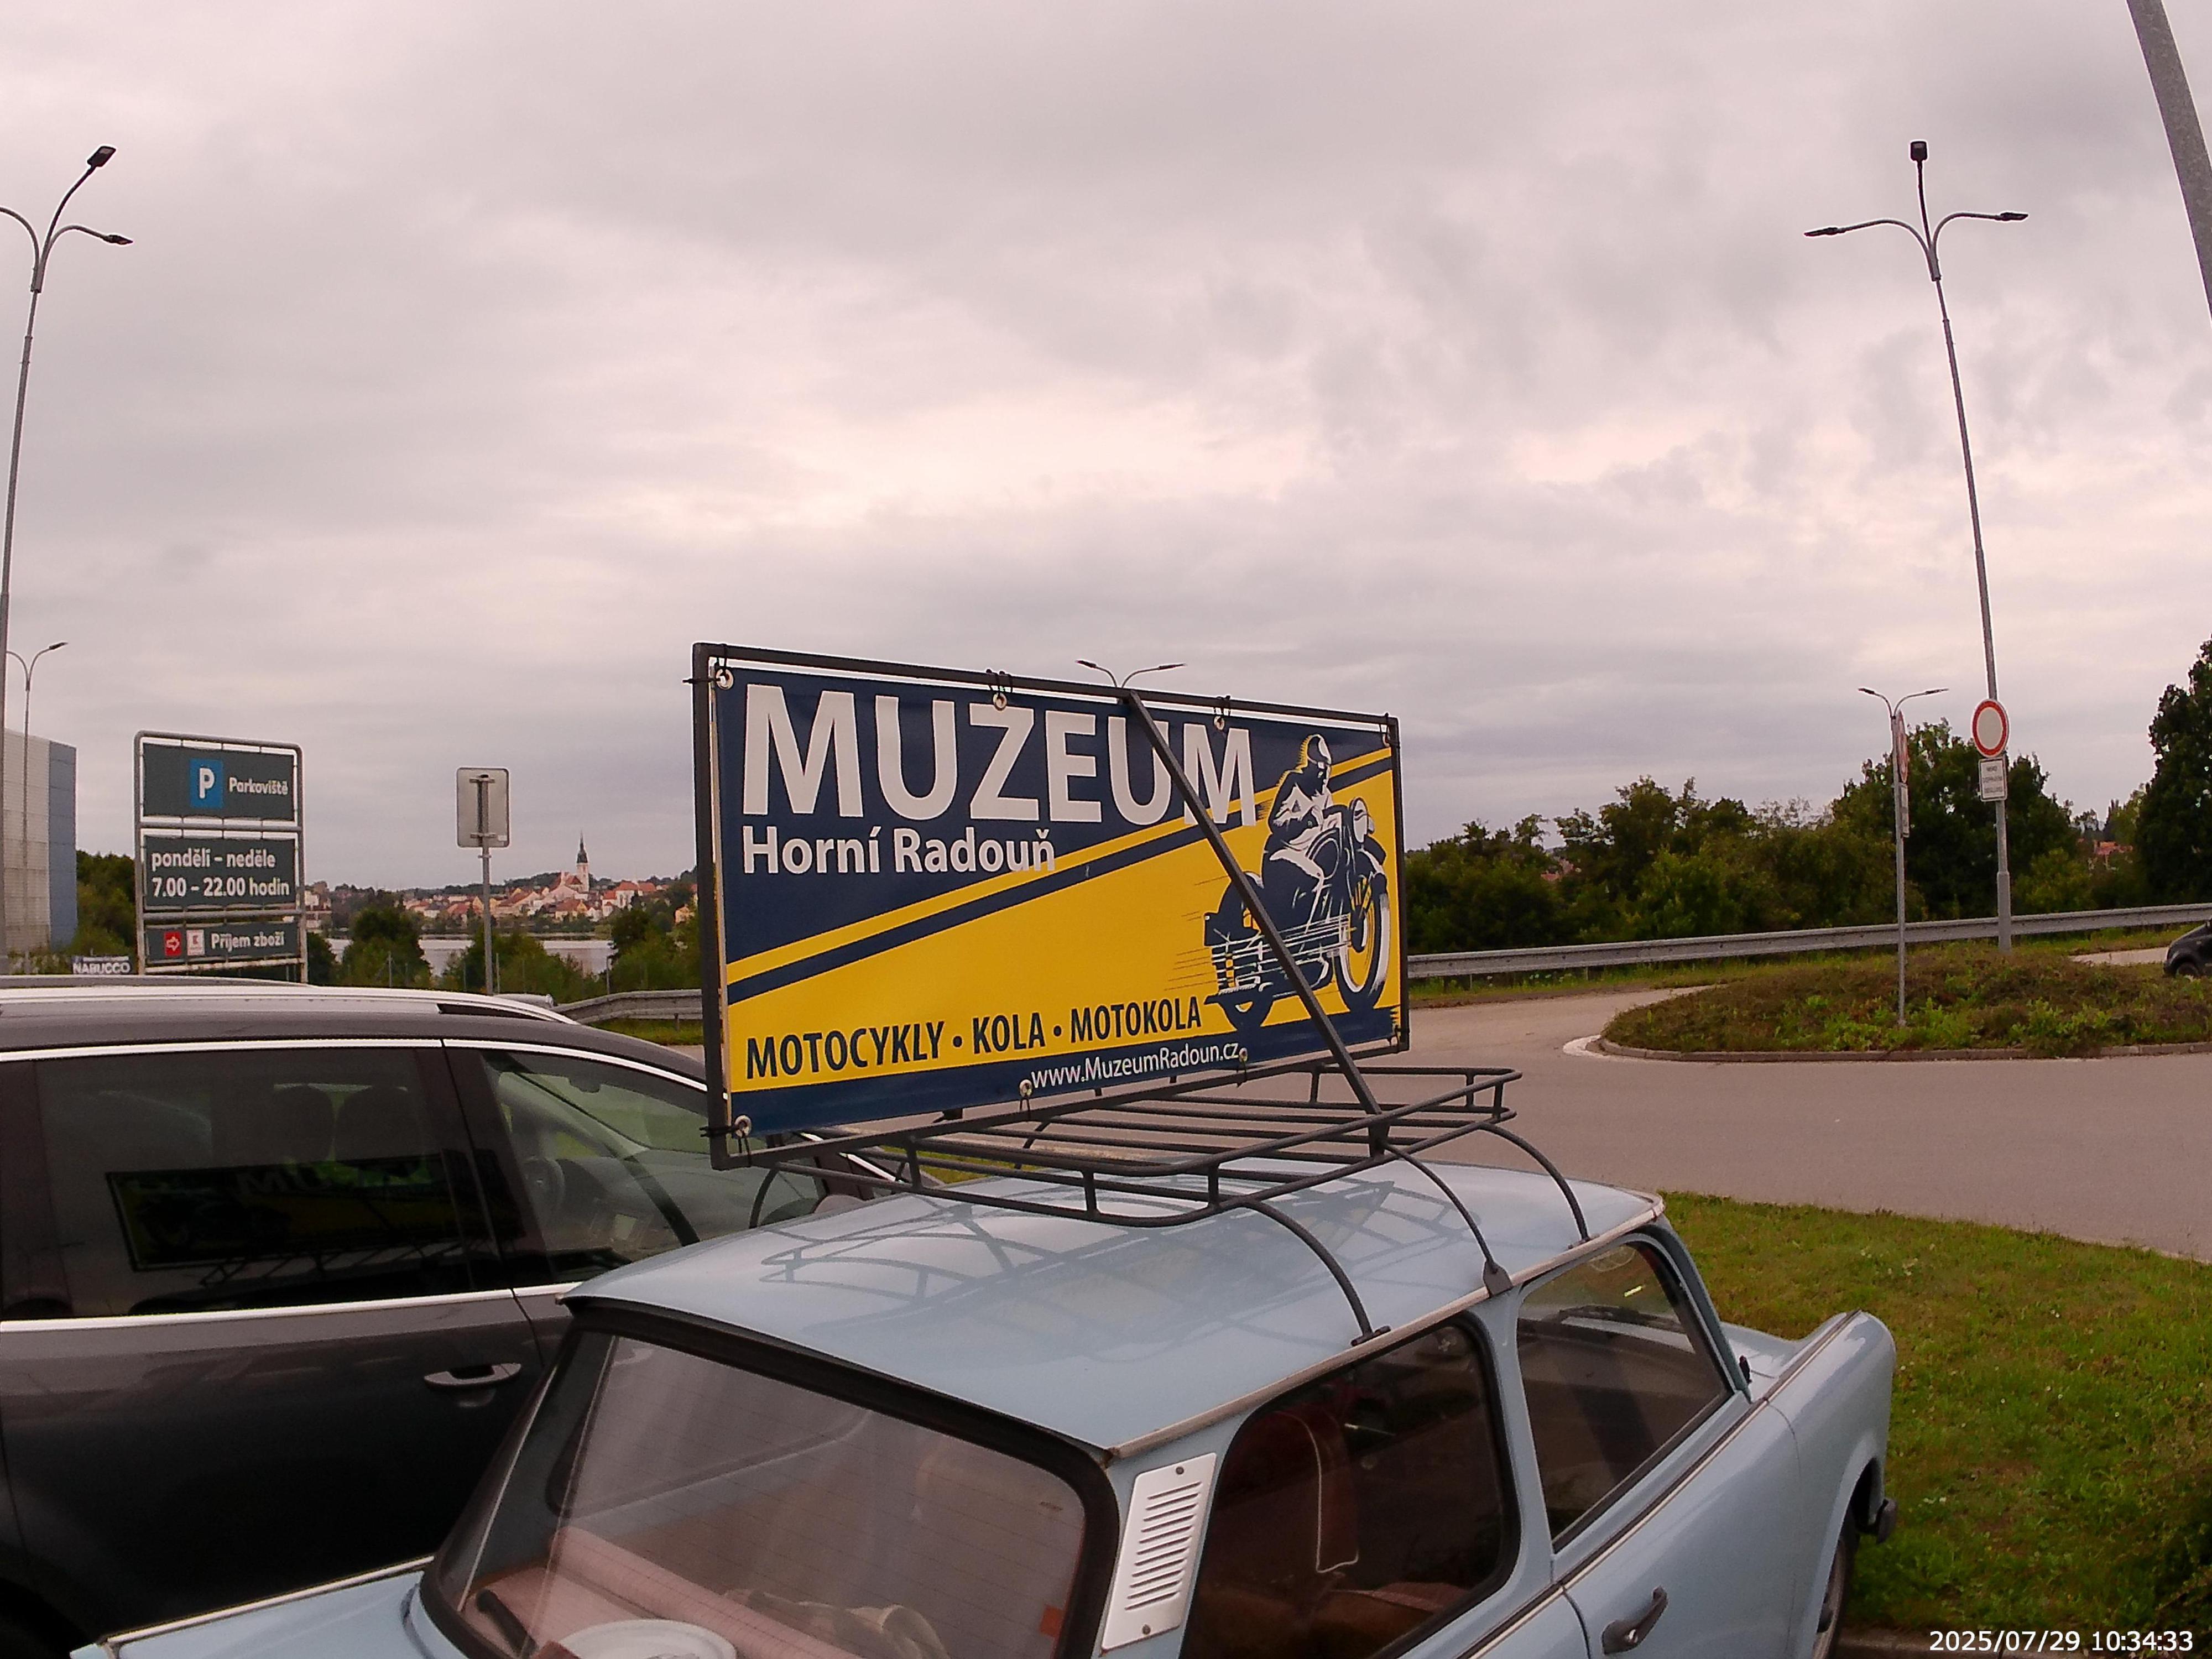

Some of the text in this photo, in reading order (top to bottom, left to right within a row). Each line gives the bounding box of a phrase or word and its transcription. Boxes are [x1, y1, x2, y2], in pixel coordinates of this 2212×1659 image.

[742, 683, 1256, 826] MUZEUM
[199, 767, 215, 799] P
[228, 776, 289, 795] Parkoviště
[226, 848, 276, 868] neděle
[742, 825, 1056, 874] Horní Radouň
[152, 877, 187, 897] 7.00
[203, 877, 246, 896] 22.00
[249, 877, 290, 896] hodin
[210, 932, 251, 952] Příjem
[253, 930, 285, 947] zboží
[72, 962, 131, 974] NABUCCO
[745, 996, 1202, 1079] MOTOCYKLY KOLA MOTOKOLA
[1031, 1042, 1239, 1089] www.MuzeumRadoun.cz
